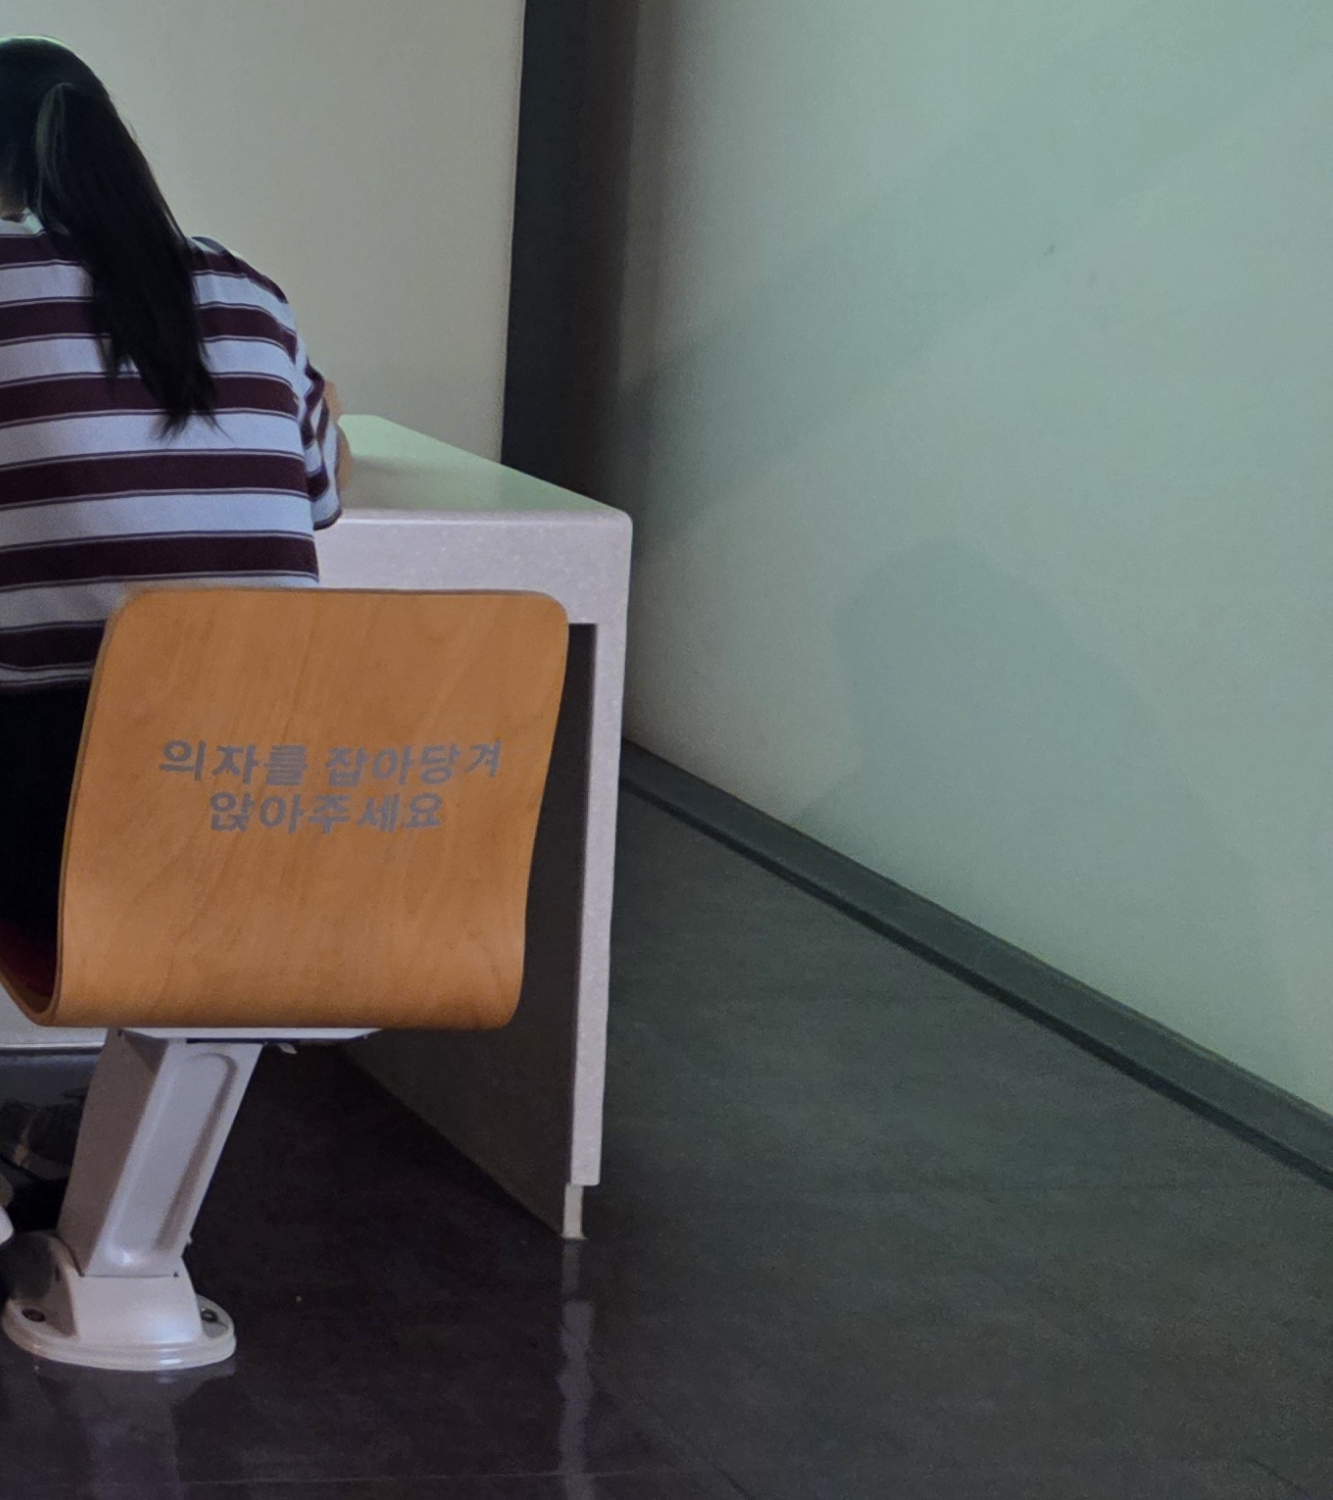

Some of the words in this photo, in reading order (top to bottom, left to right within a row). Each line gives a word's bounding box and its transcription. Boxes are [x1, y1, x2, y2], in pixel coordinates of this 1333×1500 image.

[159, 739, 309, 787] 의자를
[325, 737, 502, 789] 잡아당겨
[208, 791, 444, 835] 앉아주세요
